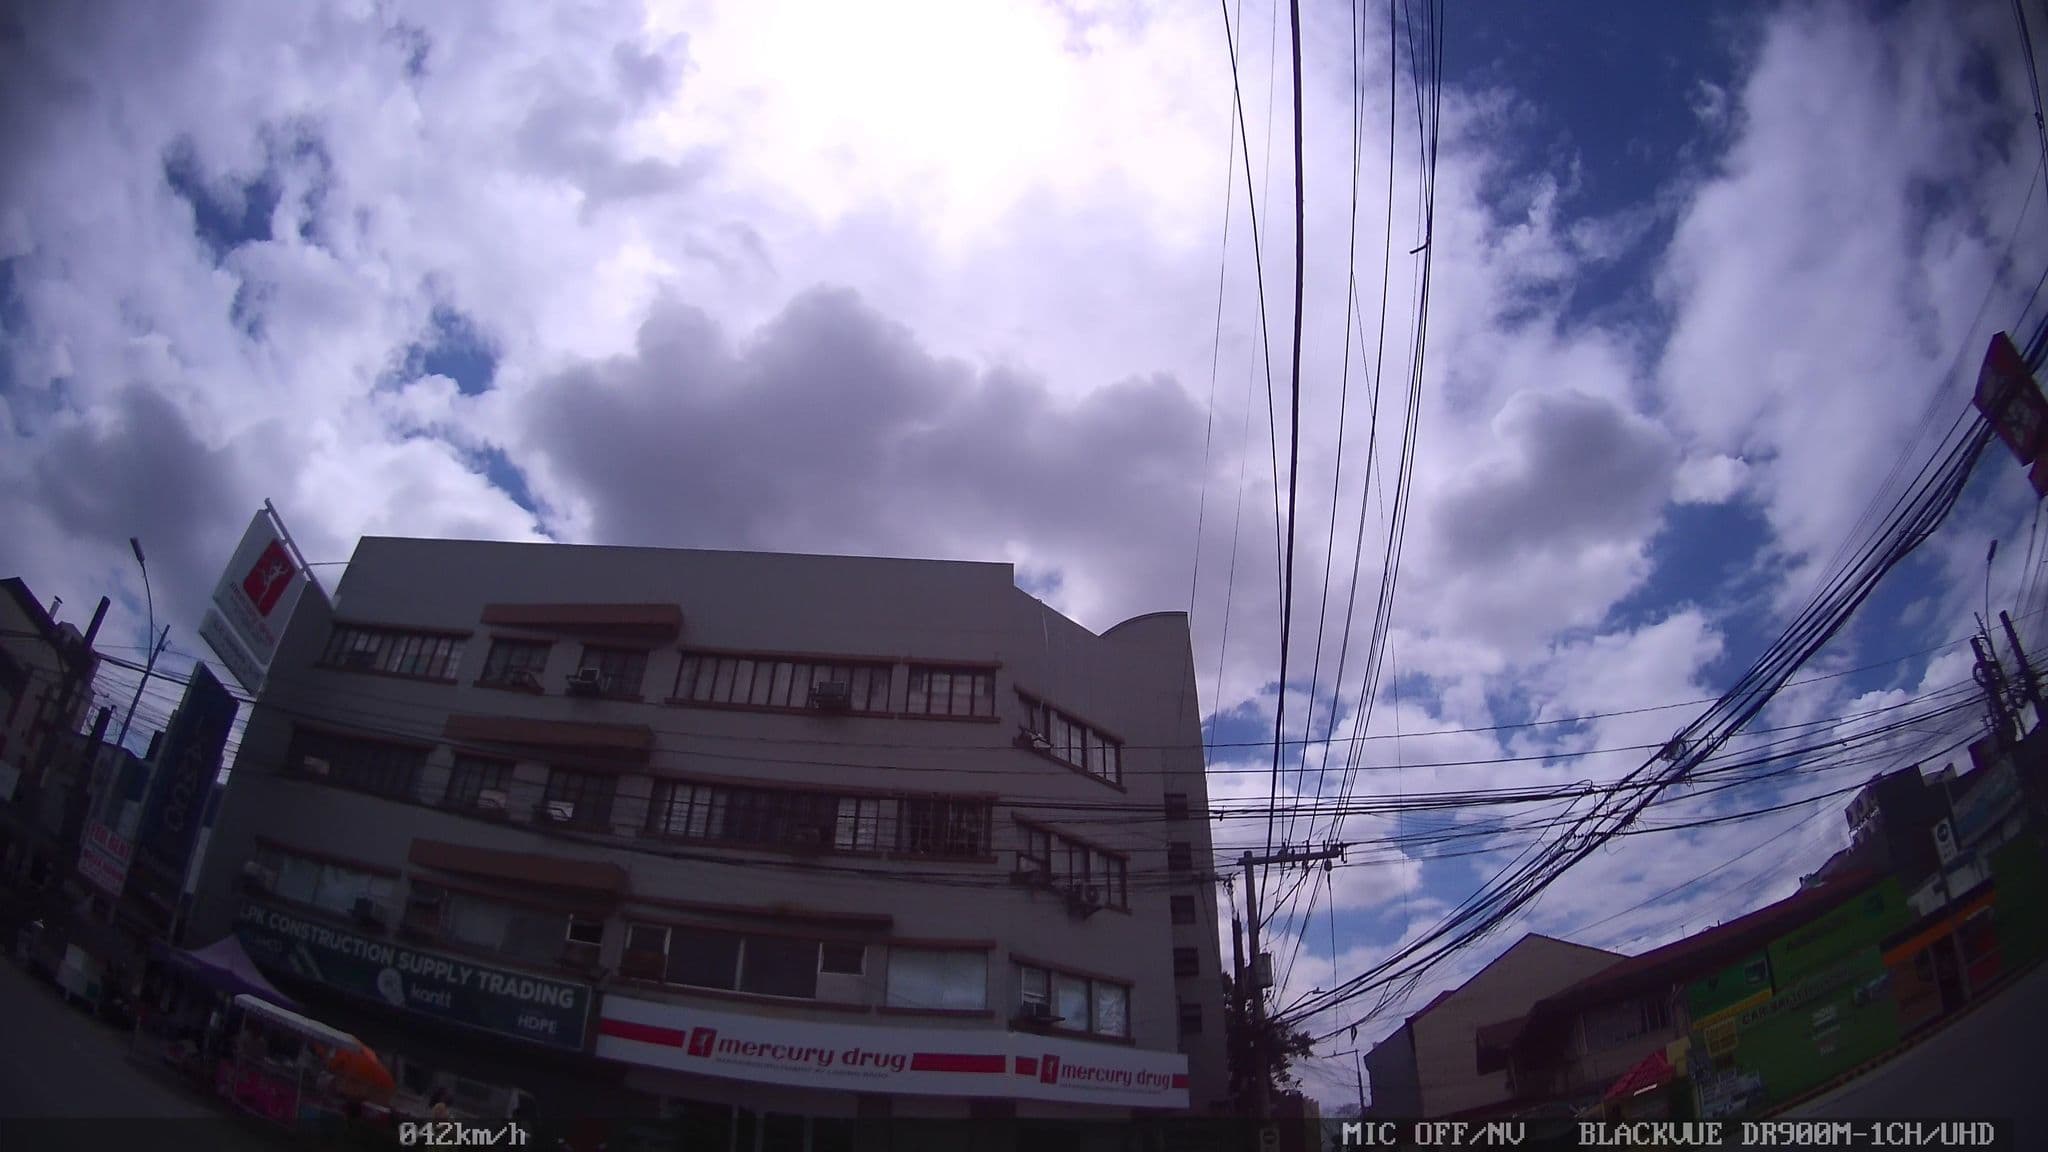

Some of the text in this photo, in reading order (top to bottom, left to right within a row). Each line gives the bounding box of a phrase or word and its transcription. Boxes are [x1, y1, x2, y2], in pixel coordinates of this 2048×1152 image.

[269, 912, 396, 966] CONSTRUCTION
[398, 951, 473, 986] SUPPLY
[476, 970, 575, 1009] TRADING
[517, 1015, 559, 1036] HDPE
[717, 1036, 835, 1067] mercury
[841, 1046, 907, 1073] drug
[1061, 1063, 1133, 1088] mercury
[1136, 1066, 1171, 1090] drug
